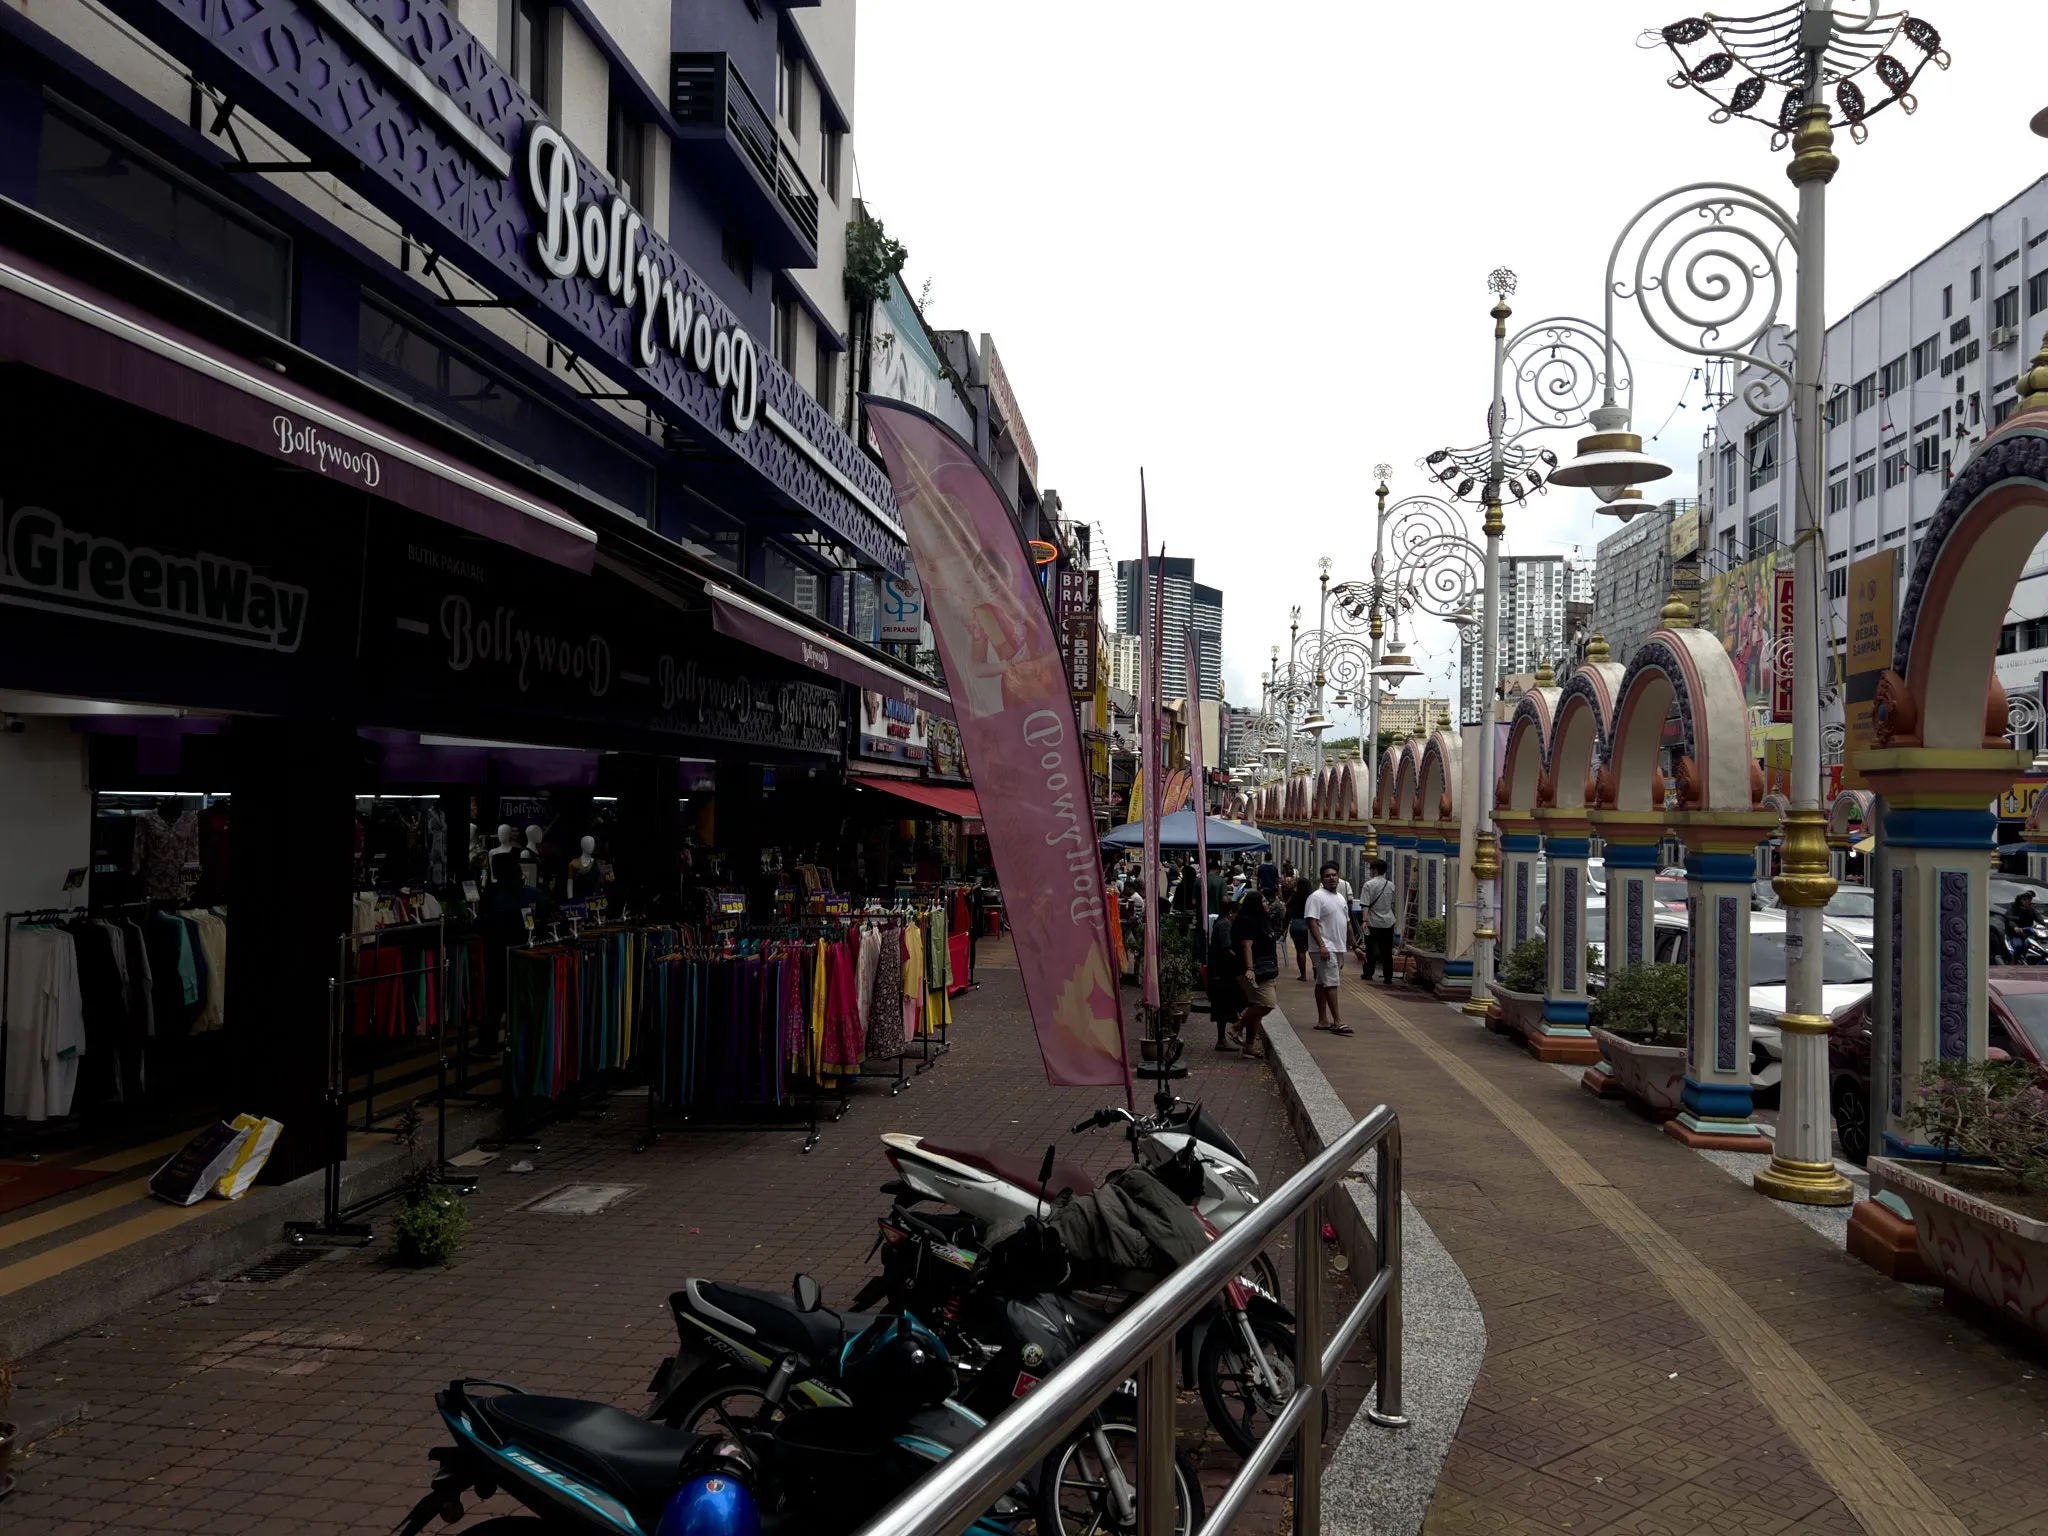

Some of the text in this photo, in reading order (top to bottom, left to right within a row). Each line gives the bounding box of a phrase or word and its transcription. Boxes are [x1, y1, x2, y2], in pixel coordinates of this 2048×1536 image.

[407, 543, 440, 571] BUTIK
[8, 507, 308, 653] GreenWay
[882, 625, 918, 633] SRI PAANDI
[1859, 610, 1874, 625] ZON
[1942, 1191, 2020, 1233] BRICKFIELDS
